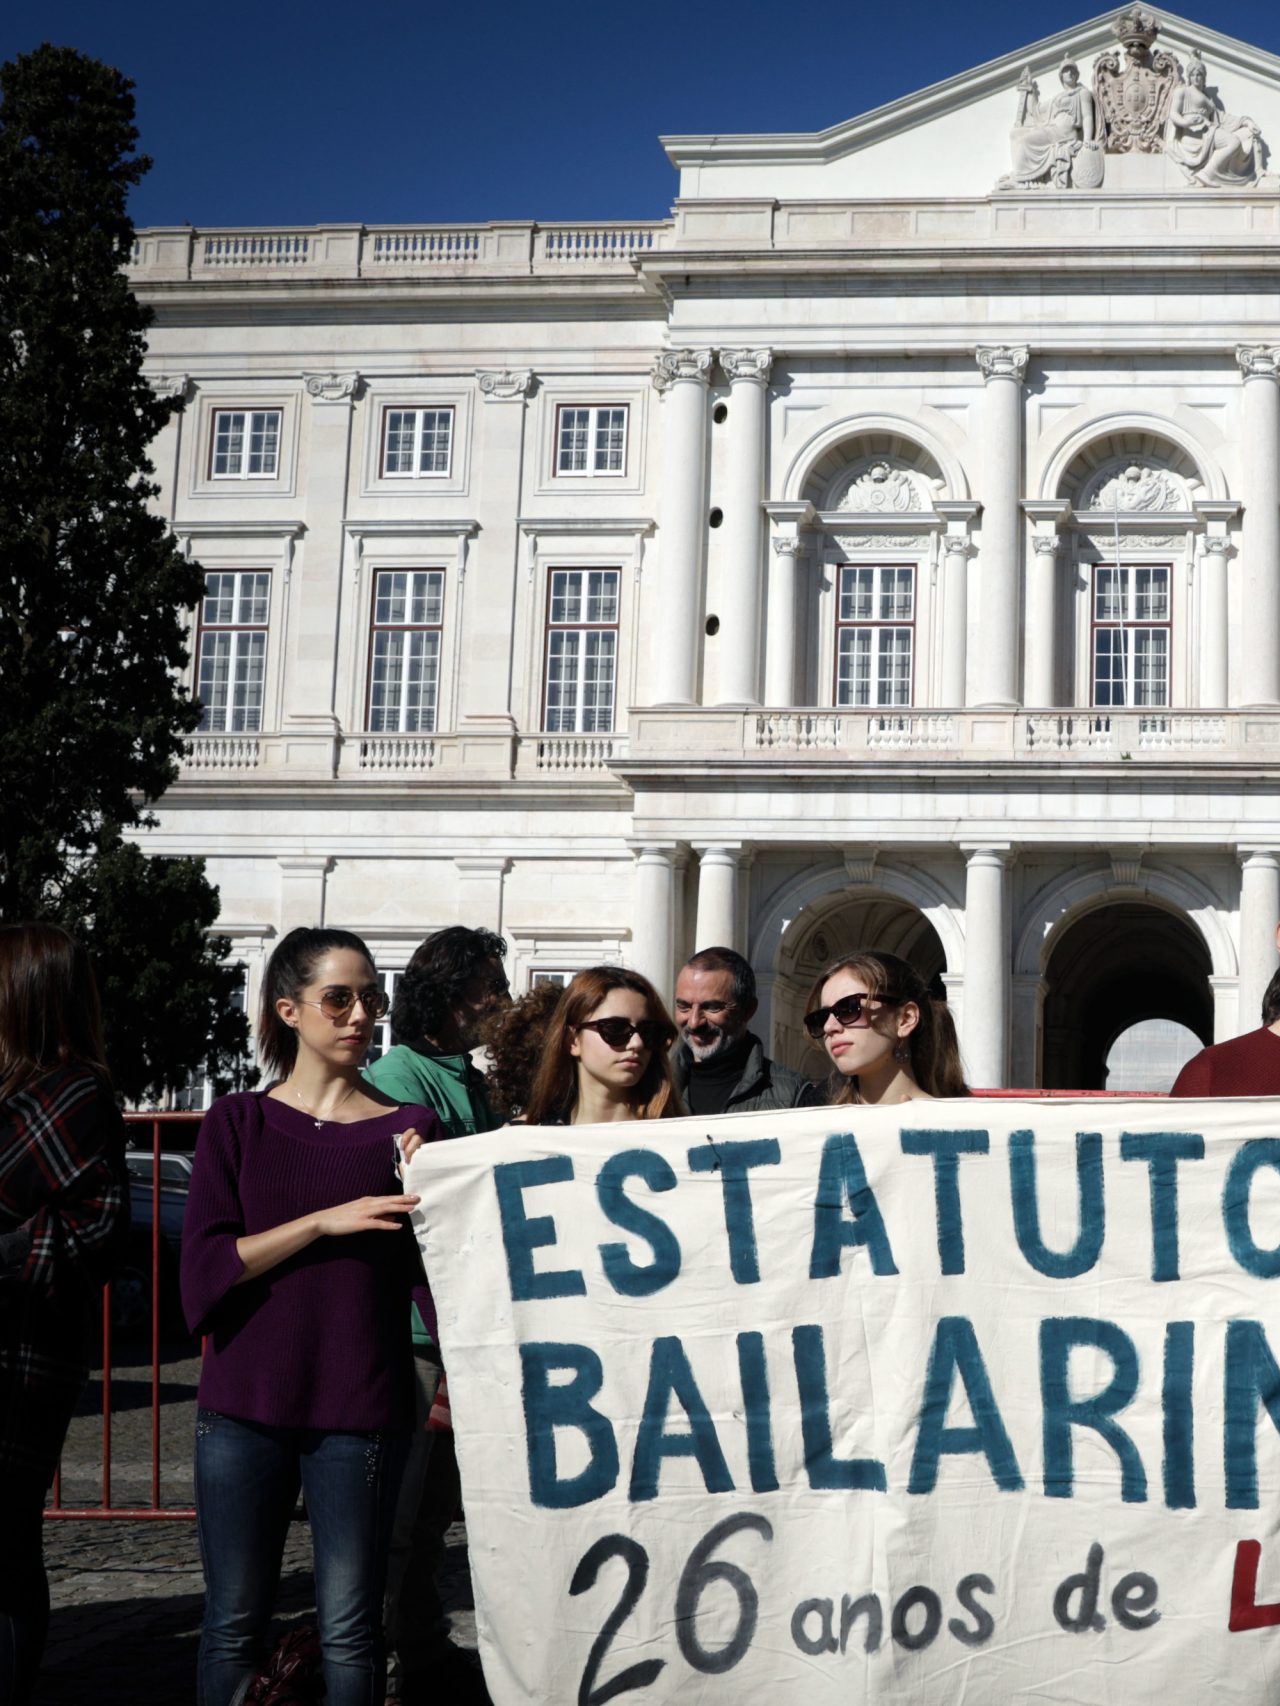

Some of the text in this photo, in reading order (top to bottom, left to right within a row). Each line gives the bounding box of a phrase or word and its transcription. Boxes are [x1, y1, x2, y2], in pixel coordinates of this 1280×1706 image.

[569, 1513, 773, 1706] 26
[791, 1575, 995, 1655] anos
[1054, 1543, 1160, 1633] de
